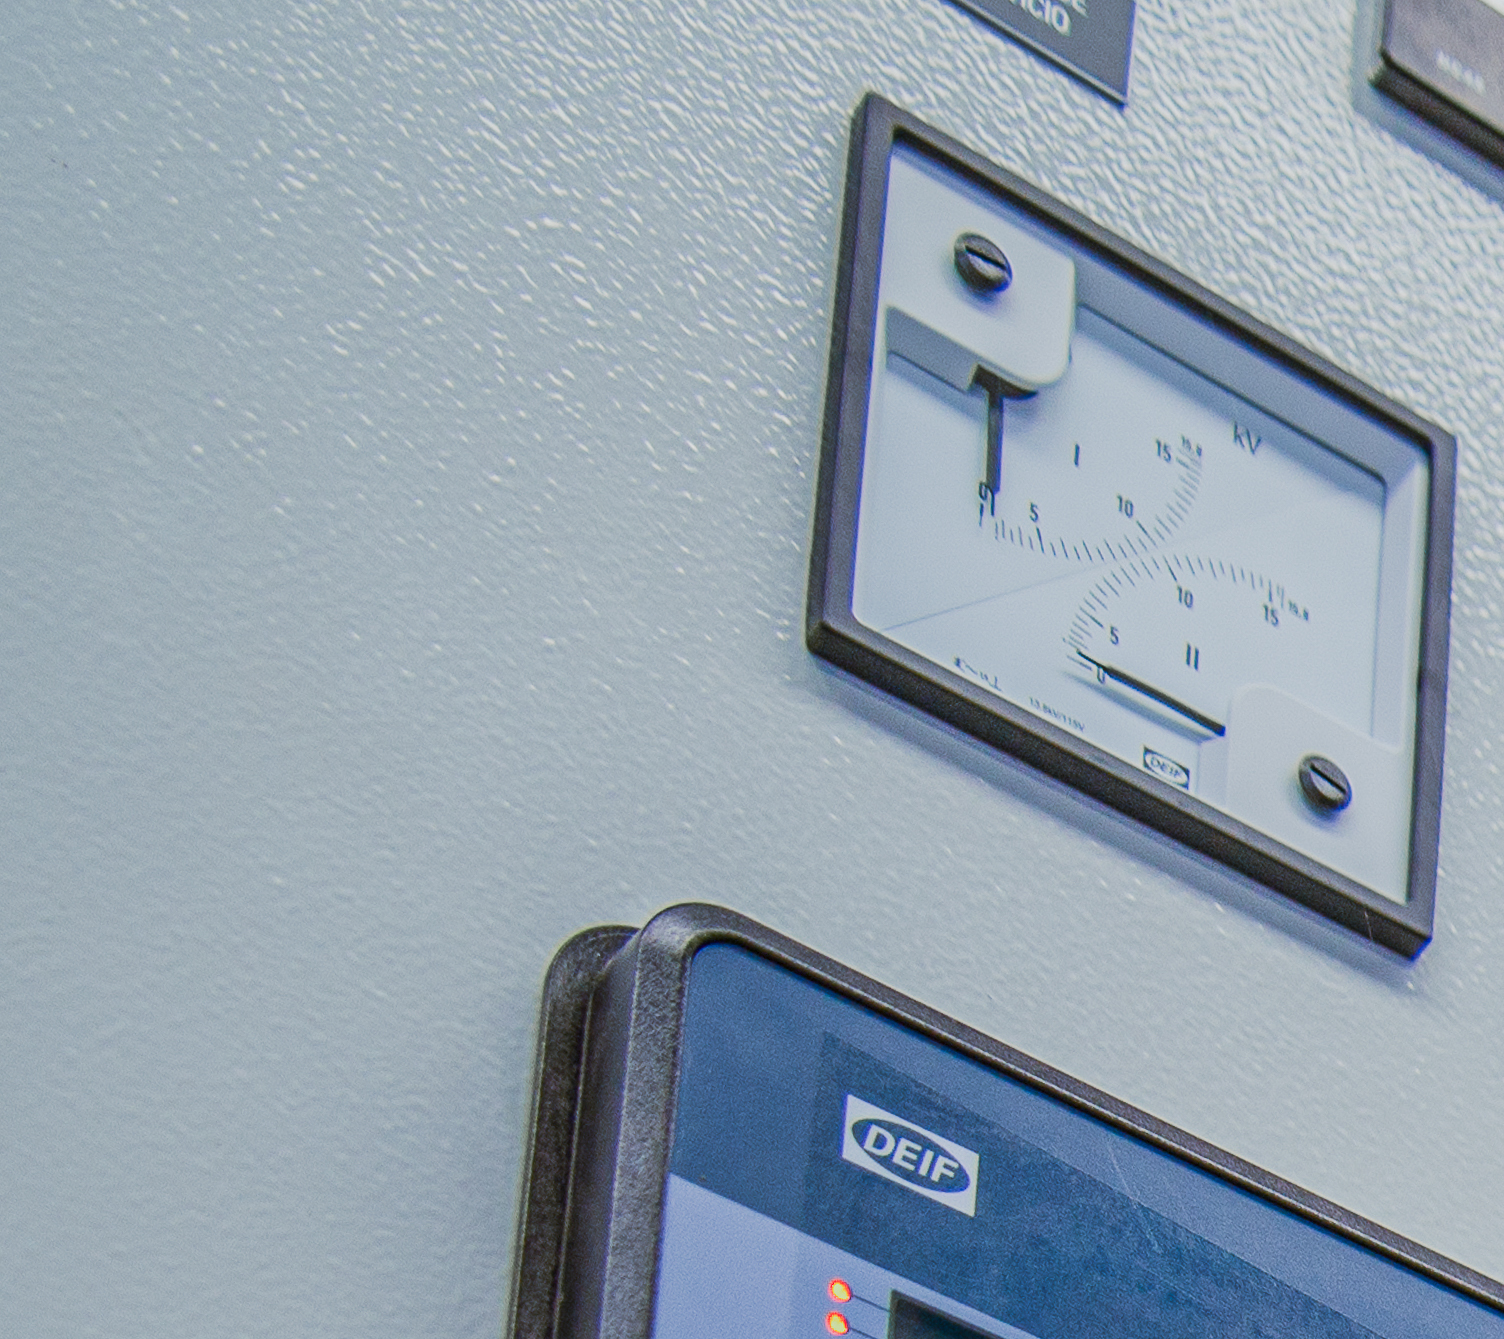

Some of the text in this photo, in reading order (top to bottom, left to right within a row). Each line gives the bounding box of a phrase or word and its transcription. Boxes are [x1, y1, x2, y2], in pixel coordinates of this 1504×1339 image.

[1232, 420, 1262, 455] kV
[1155, 438, 1172, 463] 15
[1029, 502, 1040, 523] 5
[1116, 493, 1134, 519] 10
[1176, 585, 1194, 609] 10
[1262, 604, 1279, 627] 15
[1109, 625, 1120, 646] 5
[862, 1123, 960, 1183] DEIF
